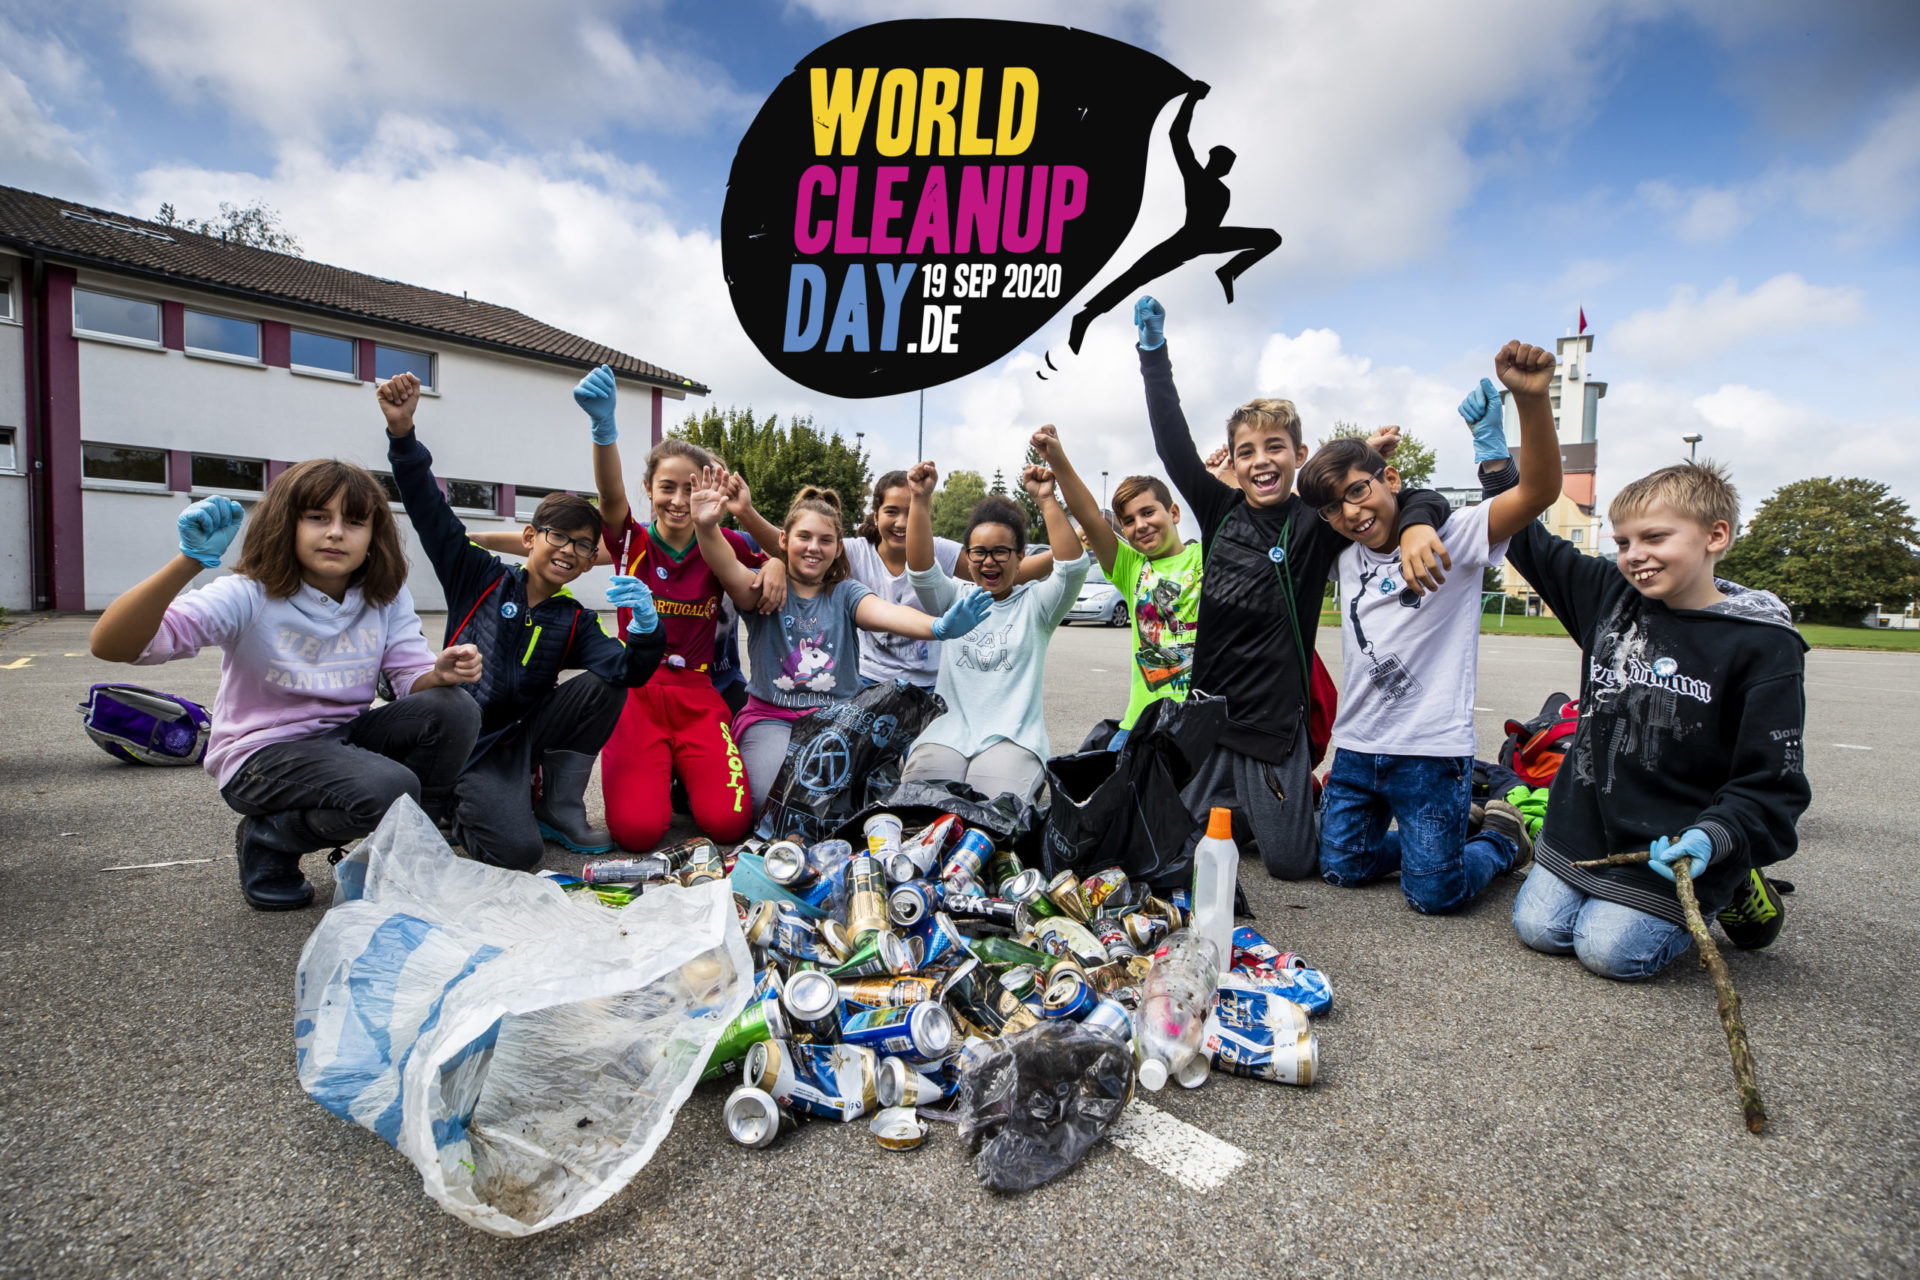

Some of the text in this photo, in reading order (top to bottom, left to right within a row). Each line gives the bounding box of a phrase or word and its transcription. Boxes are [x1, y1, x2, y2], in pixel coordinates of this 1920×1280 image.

[653, 599, 704, 616] RTUGAL
[265, 664, 377, 690] PANTHERS
[772, 691, 836, 708] UNICORN
